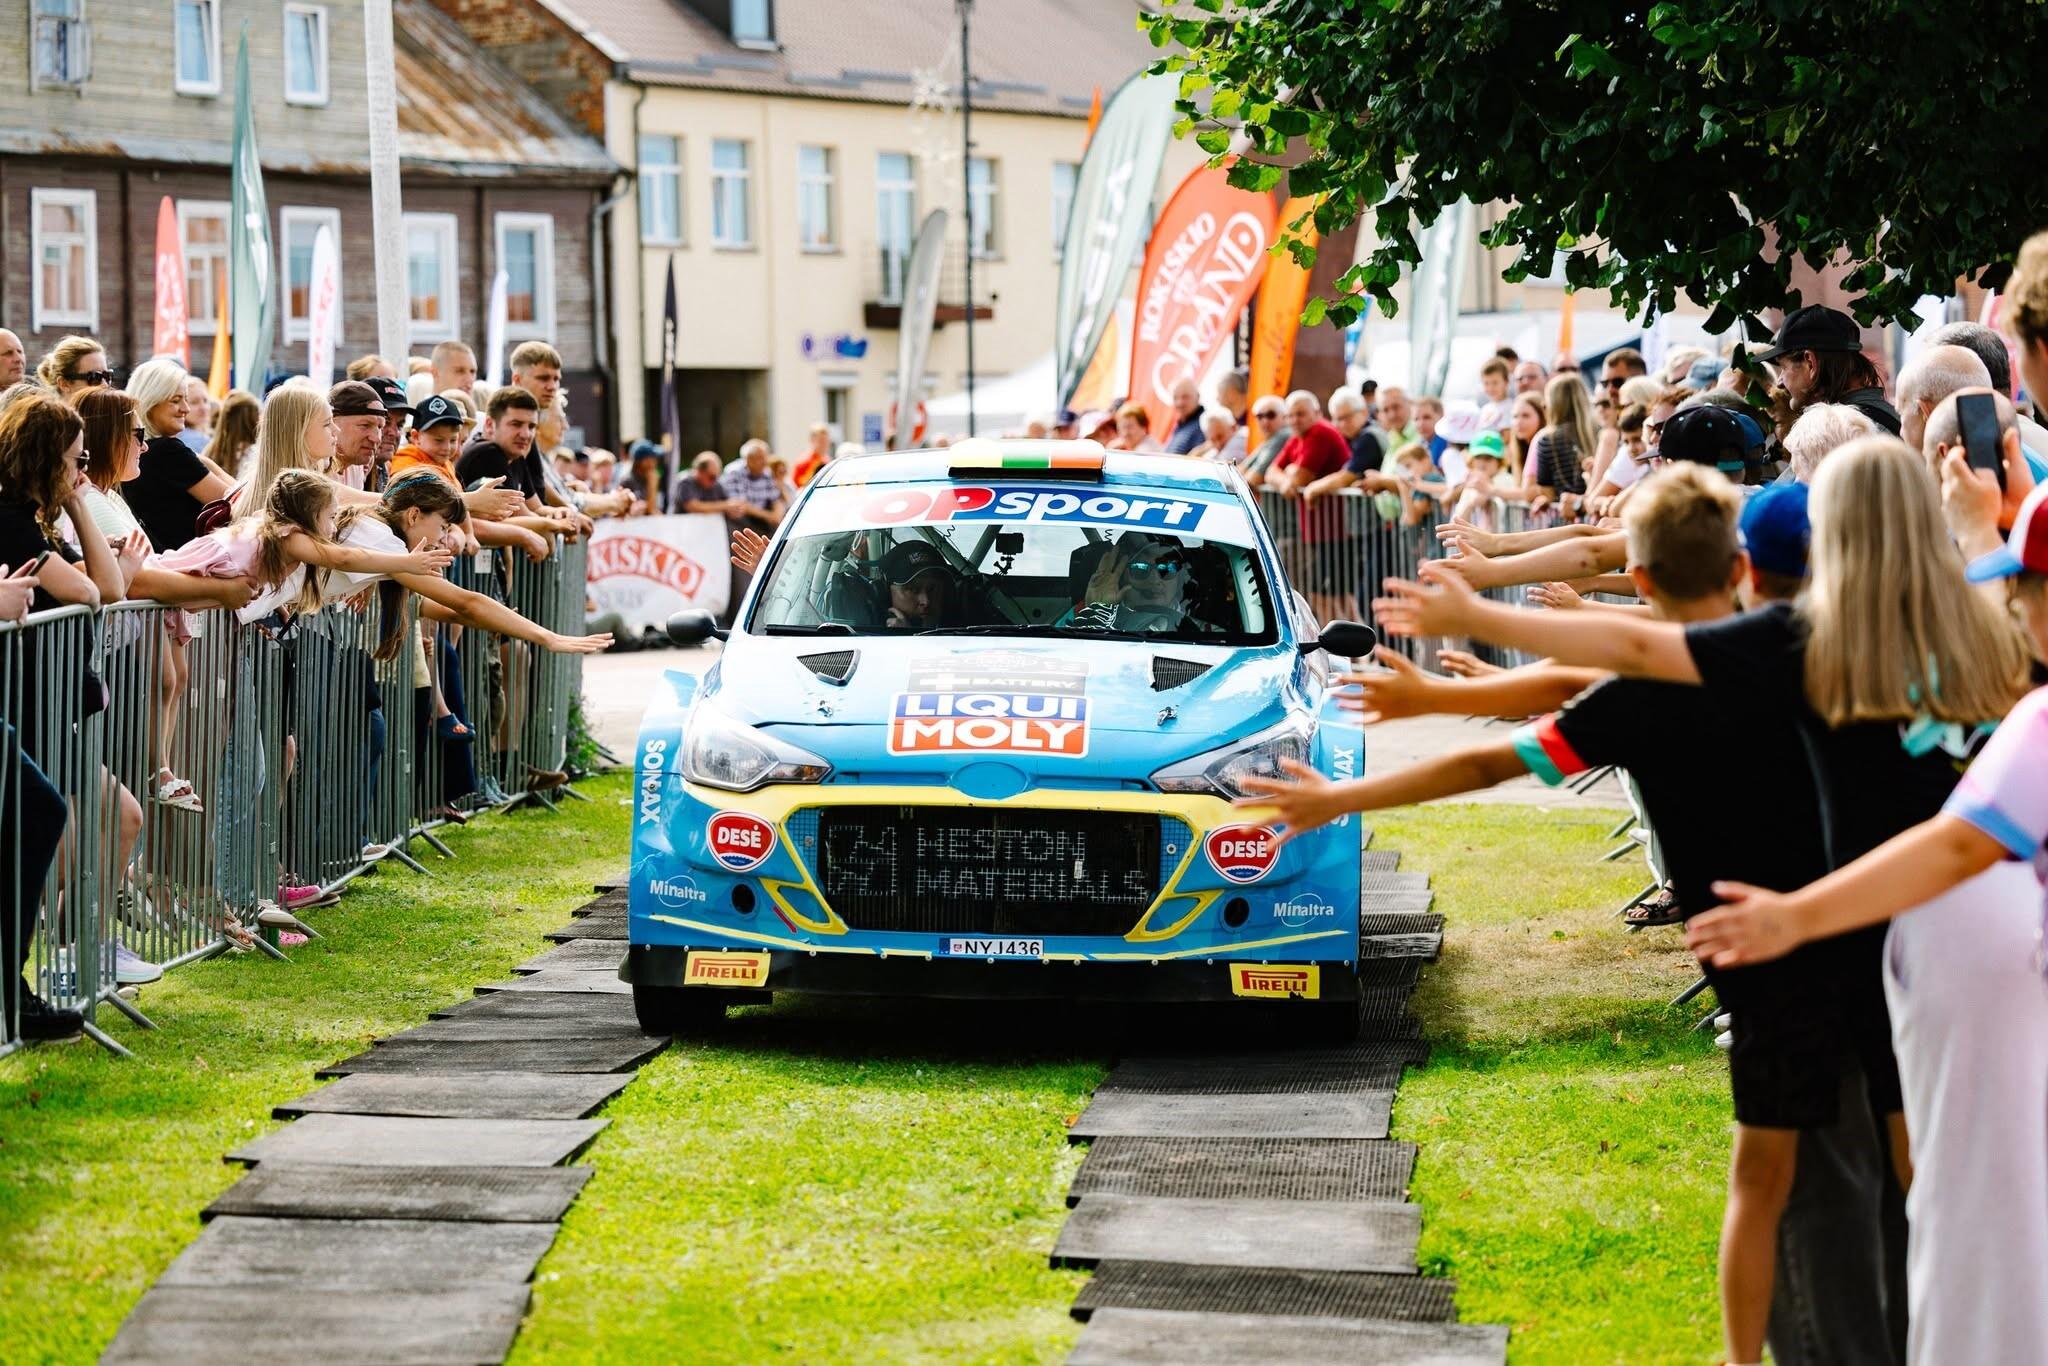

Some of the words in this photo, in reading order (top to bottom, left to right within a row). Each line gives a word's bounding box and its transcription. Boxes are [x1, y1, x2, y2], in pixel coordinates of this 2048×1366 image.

[1151, 211, 1265, 407] GRAND
[972, 678, 1077, 689] BATTERY
[904, 694, 1077, 718] LIQUI
[901, 718, 1083, 750] MOLY
[640, 739, 667, 825] SONAX
[1331, 745, 1354, 827] SAX
[717, 825, 762, 848] DESĖ
[917, 827, 1086, 861] HESTON
[1220, 835, 1268, 858] DESĖ
[650, 879, 706, 902] Minaltra
[917, 866, 1149, 903] MATERIALS
[1273, 902, 1334, 917] Minaltra
[691, 957, 759, 979] PIRELLI
[1240, 970, 1308, 992] PIRELLI
